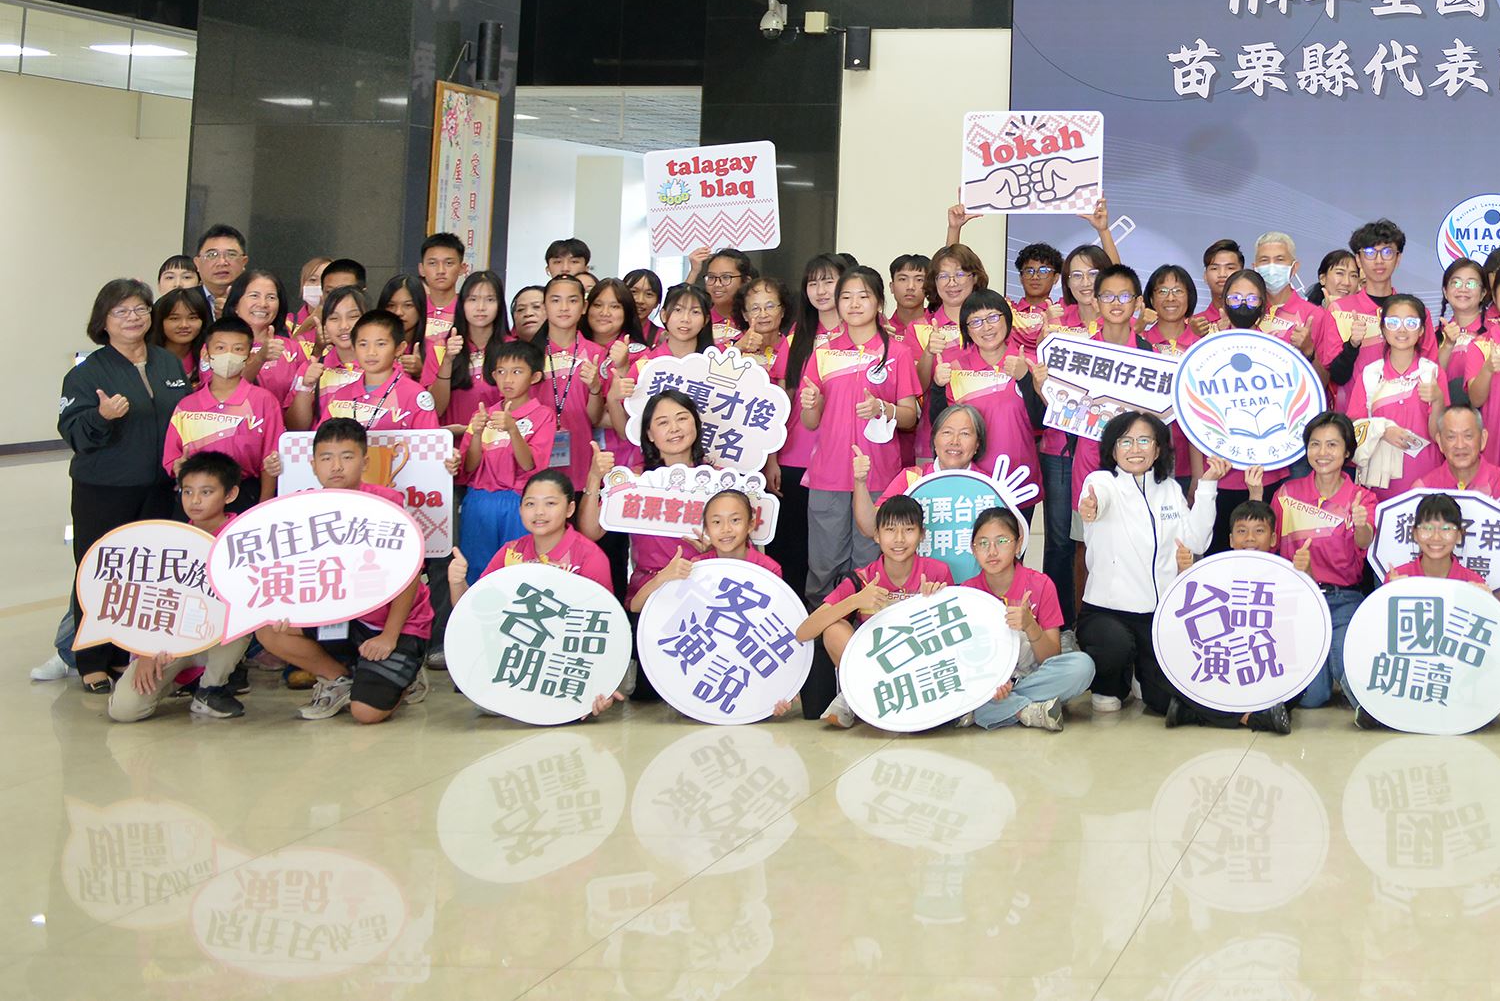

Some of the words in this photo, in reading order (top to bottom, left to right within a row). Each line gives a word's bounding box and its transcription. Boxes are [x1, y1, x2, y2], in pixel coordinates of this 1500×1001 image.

[666, 152, 757, 177] talagay
[980, 125, 1084, 167] lokah
[699, 179, 756, 199] blaq
[1199, 373, 1293, 396] MIAOLI
[1230, 396, 1270, 408] TEAM
[226, 510, 408, 569] 原住民族語
[94, 545, 221, 601] 原住民族
[247, 556, 346, 608] 演說
[97, 578, 180, 636] 朗讀
[499, 582, 610, 655] 客語
[705, 577, 804, 679] 客語
[865, 596, 973, 674] 台語
[1175, 580, 1277, 644] 台語
[1387, 596, 1498, 668] 國語
[492, 643, 591, 703] 朗讀
[658, 611, 750, 715] 演說
[1190, 630, 1284, 687] 演說
[1366, 652, 1453, 707] 朗讀
[873, 657, 965, 719] 朗讀
